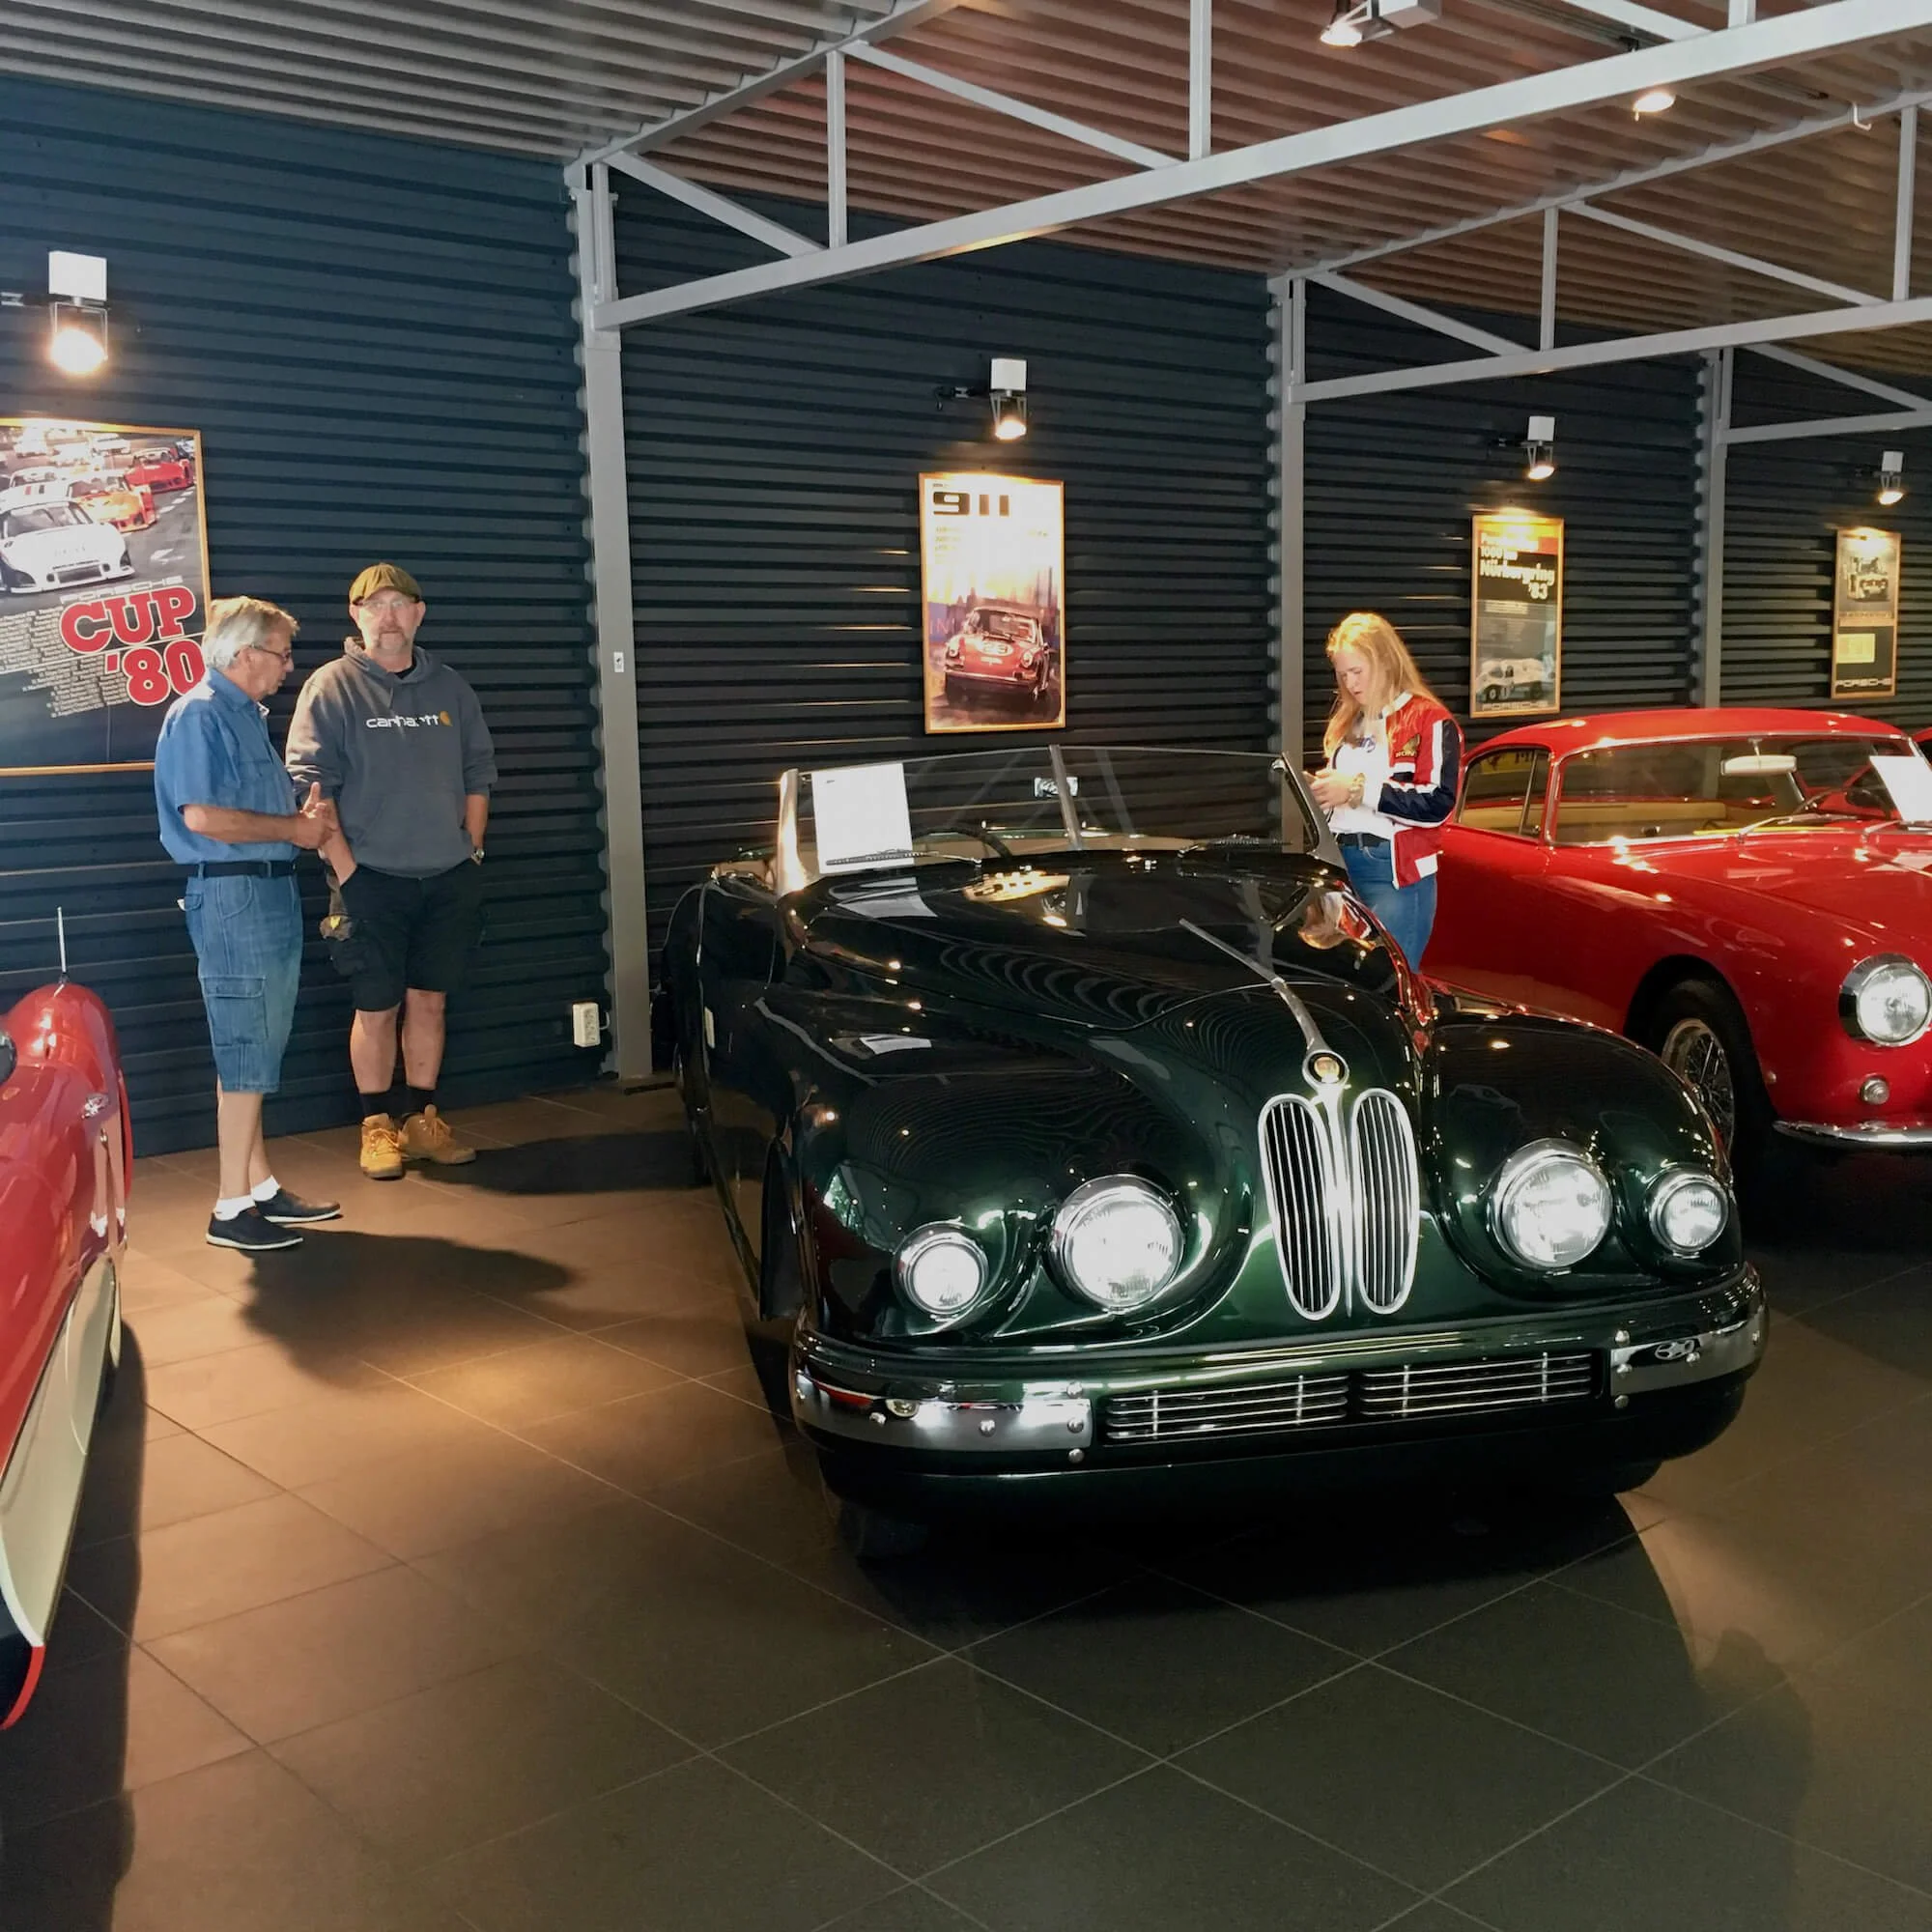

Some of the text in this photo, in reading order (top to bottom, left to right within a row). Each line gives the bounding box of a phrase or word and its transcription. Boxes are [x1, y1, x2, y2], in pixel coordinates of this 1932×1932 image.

[933, 492, 1009, 516] 911
[60, 575, 184, 605] PORSCHE
[59, 584, 196, 655] CUP
[105, 639, 206, 705] '80
